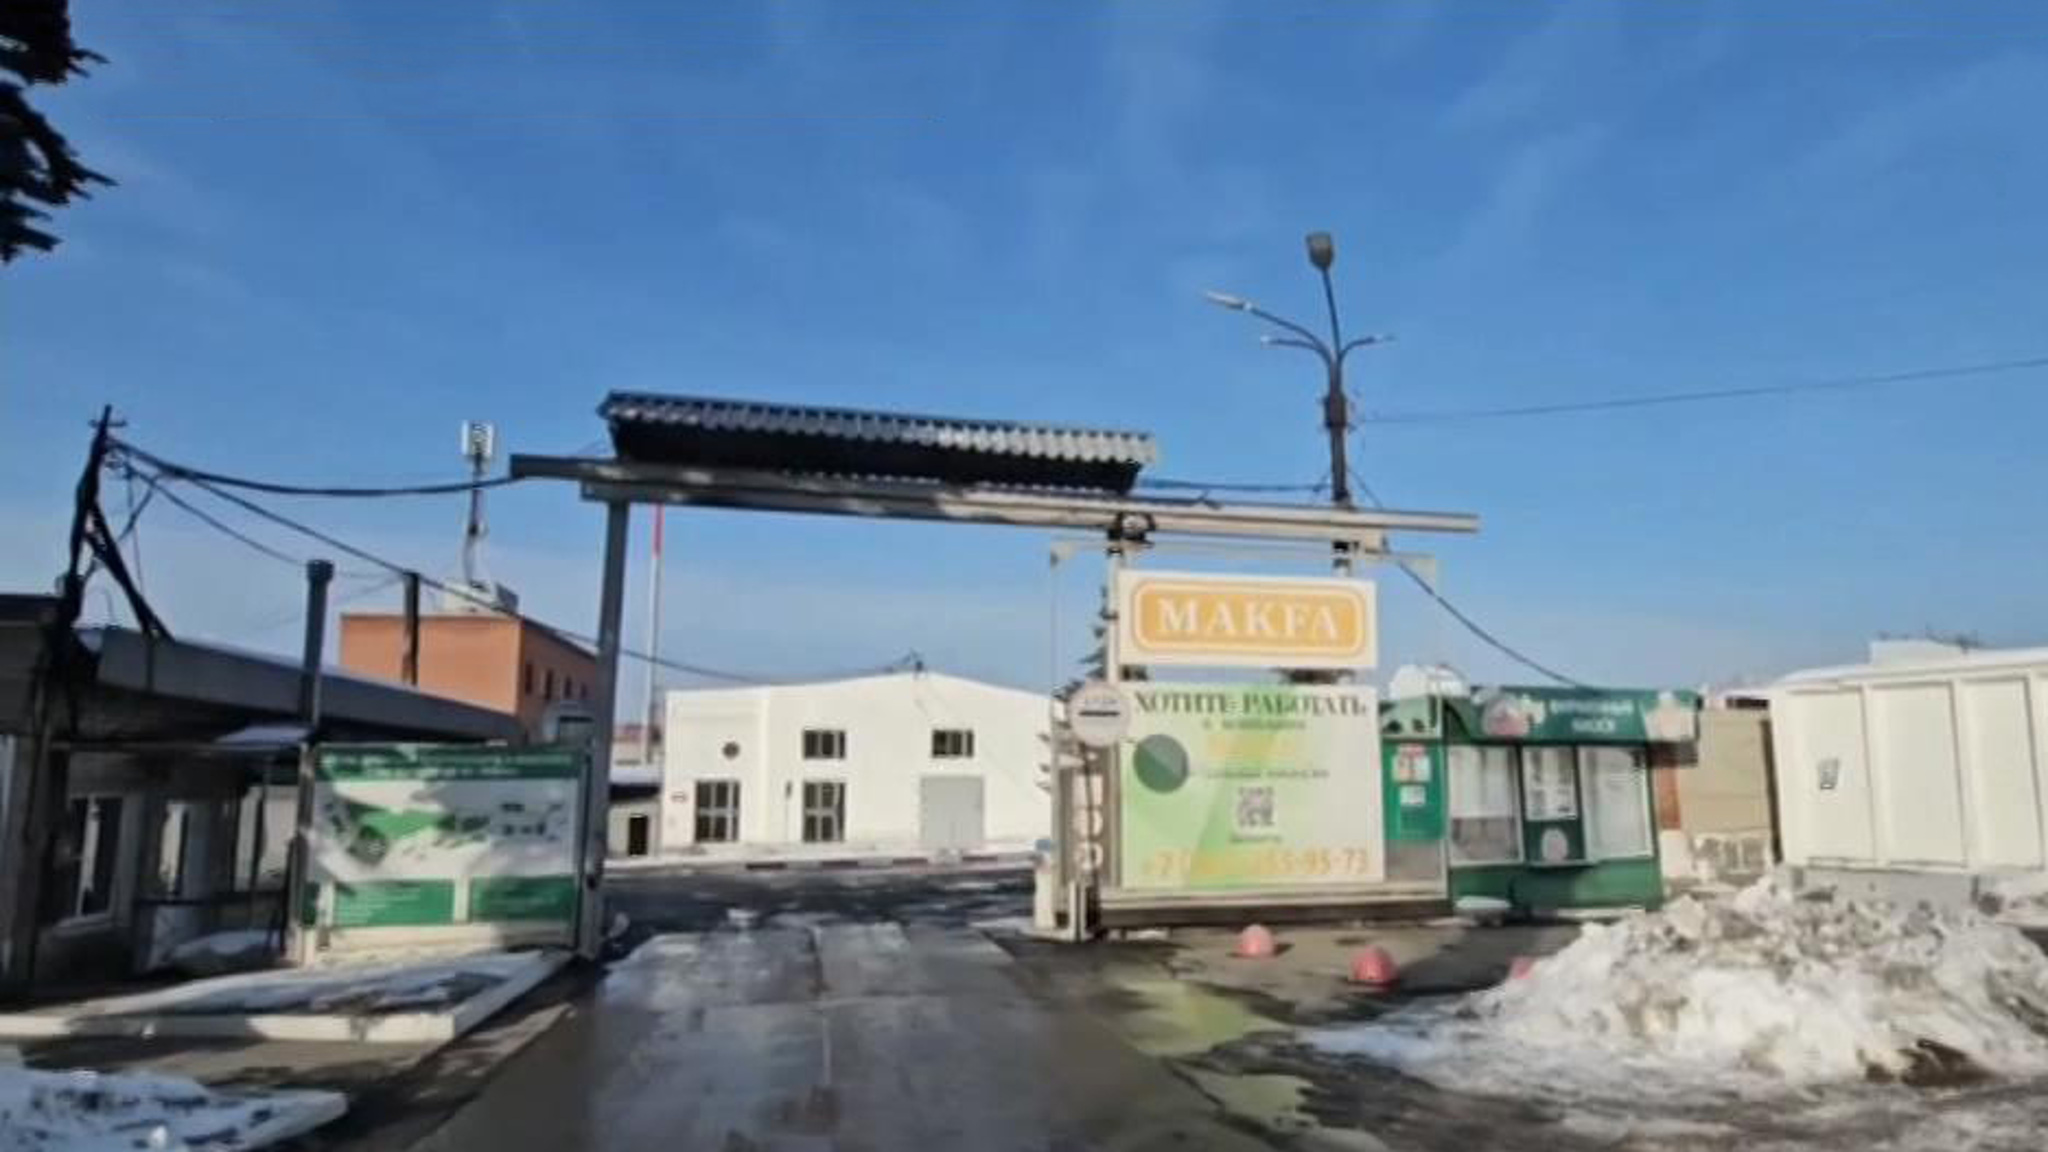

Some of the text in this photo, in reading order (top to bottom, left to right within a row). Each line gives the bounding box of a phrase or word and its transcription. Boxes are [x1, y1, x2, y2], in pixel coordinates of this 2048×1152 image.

[1158, 597, 1338, 642] MAKFA
[1134, 691, 1367, 717] ХОТИТЕ РАБОТАТЬ
